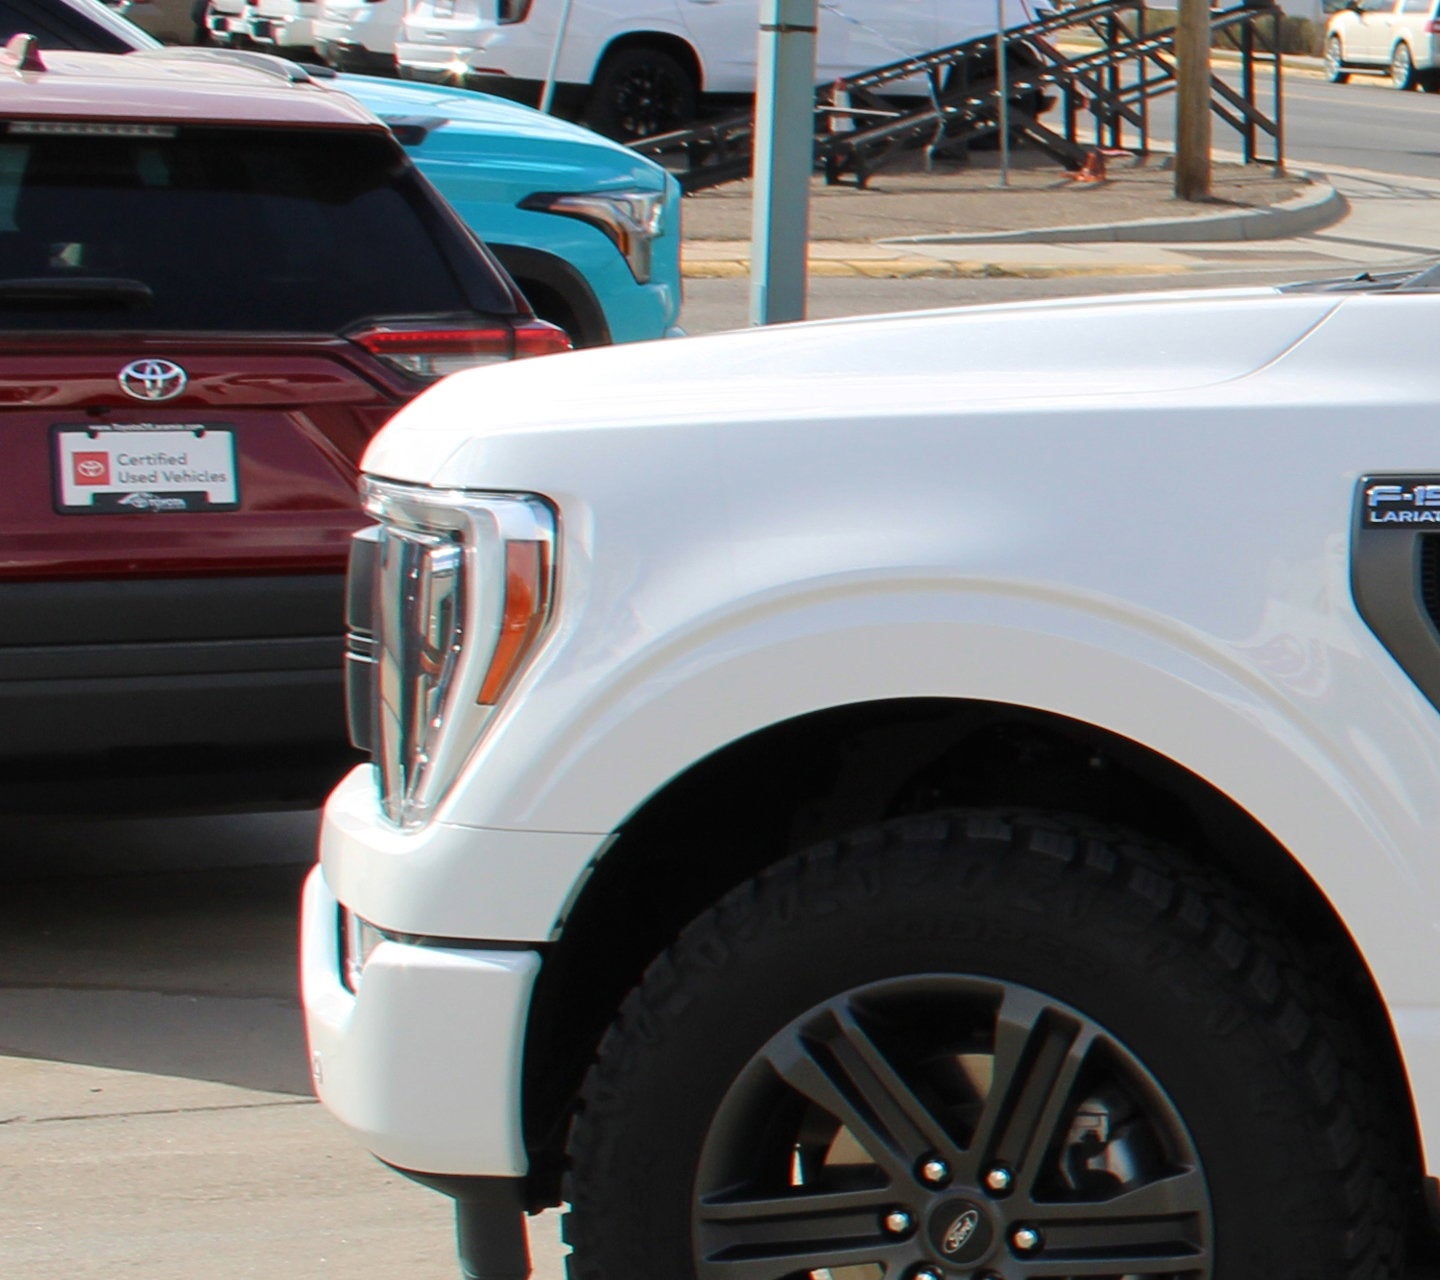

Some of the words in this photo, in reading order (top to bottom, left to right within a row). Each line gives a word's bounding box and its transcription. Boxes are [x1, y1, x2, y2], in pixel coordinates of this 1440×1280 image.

[117, 453, 188, 467] Certified
[118, 471, 159, 484] Used
[163, 470, 227, 484] Vehicles
